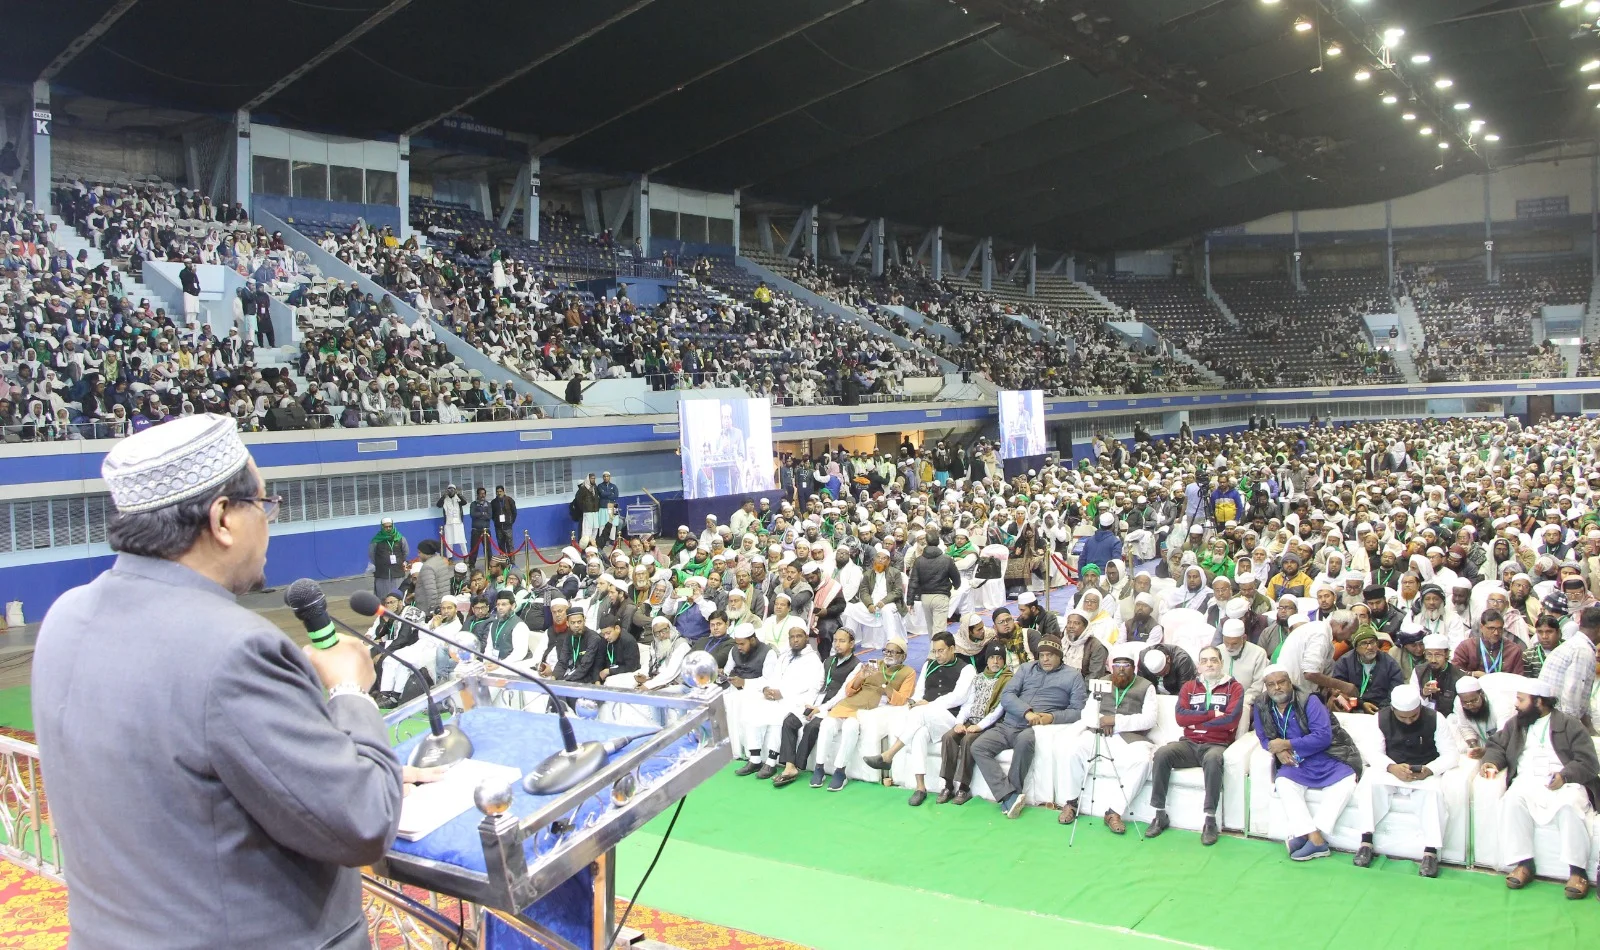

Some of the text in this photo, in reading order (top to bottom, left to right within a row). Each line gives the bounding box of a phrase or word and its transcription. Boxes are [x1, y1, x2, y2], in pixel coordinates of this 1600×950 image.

[36, 119, 50, 135] K
[443, 118, 504, 136] NO SMOKING
[532, 186, 538, 196] L
